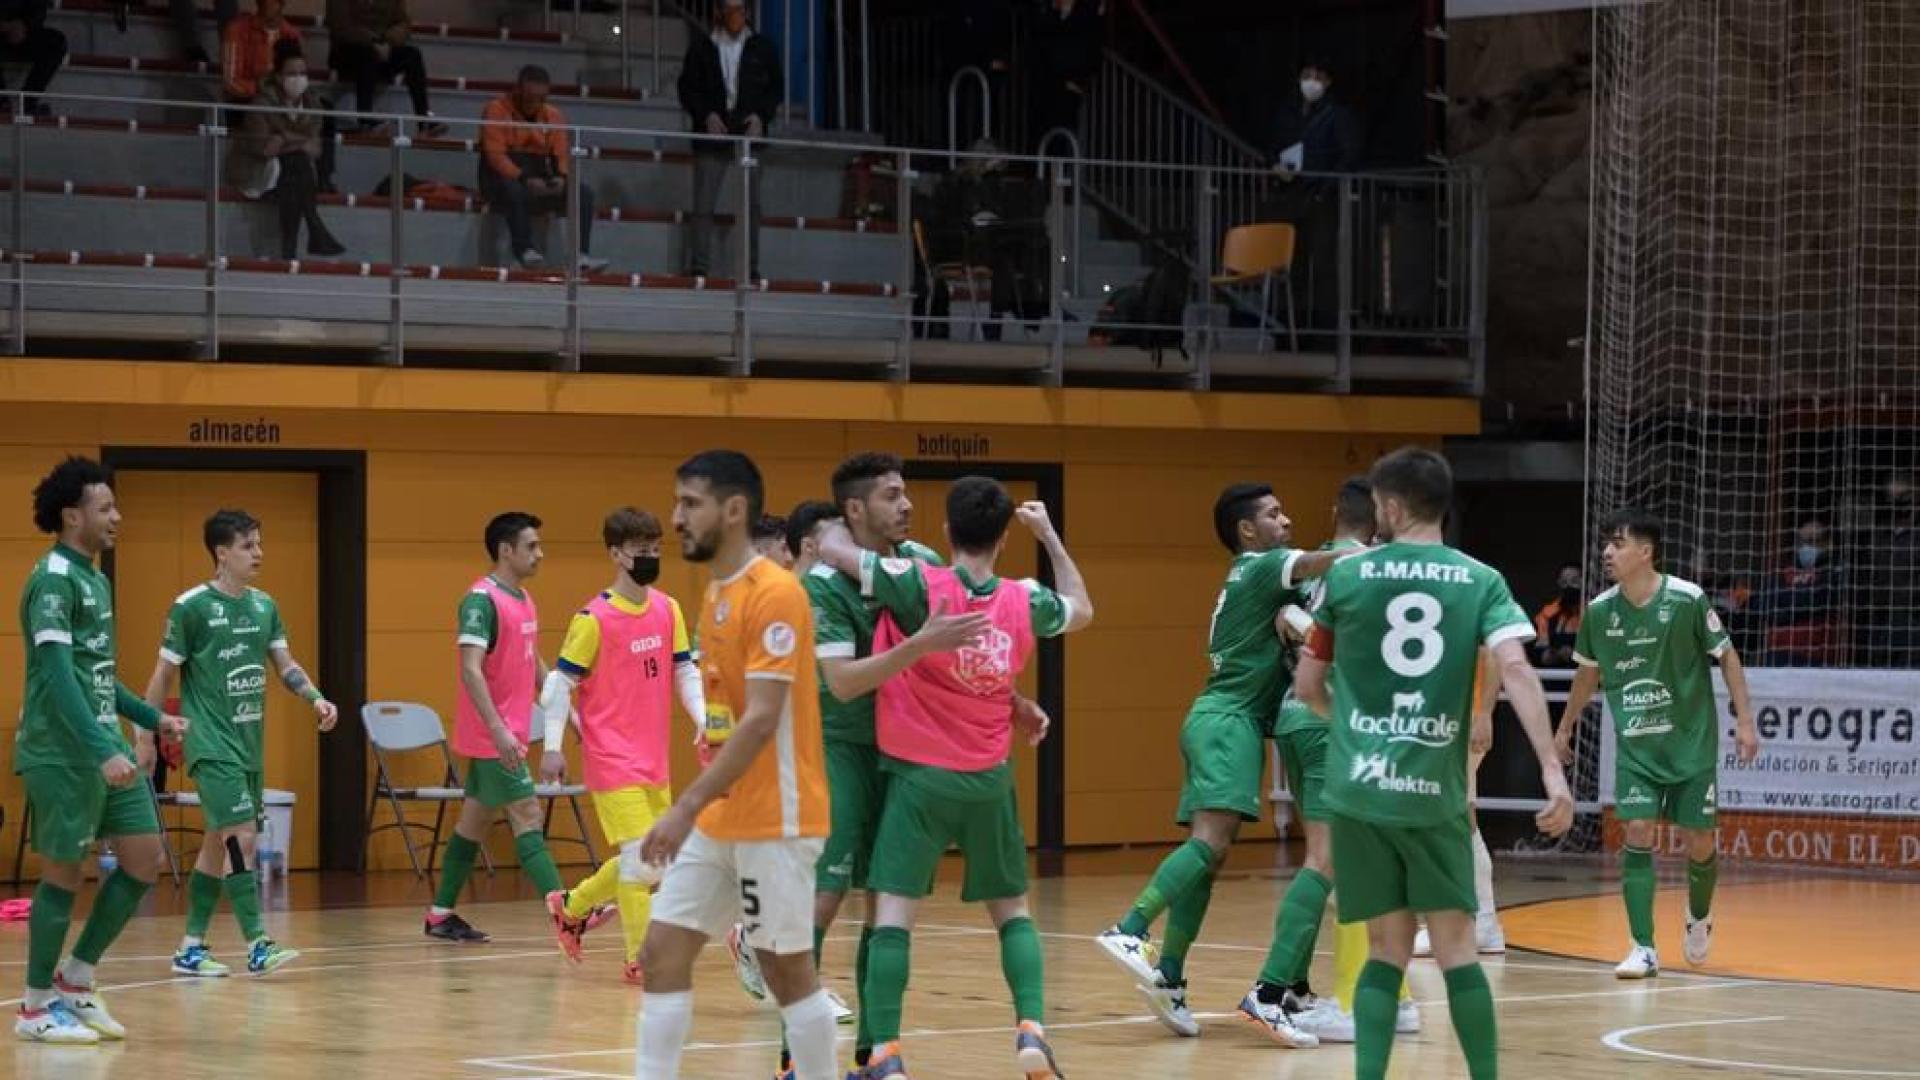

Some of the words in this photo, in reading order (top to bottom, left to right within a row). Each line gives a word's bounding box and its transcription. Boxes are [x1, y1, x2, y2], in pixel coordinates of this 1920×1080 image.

[189, 416, 280, 443] almacén
[1381, 592, 1444, 677] 8
[643, 656, 658, 679] 19
[1826, 755, 1839, 773] &
[1766, 829, 1833, 862] CON
[1849, 833, 1886, 865] EL
[741, 878, 760, 915] 5
